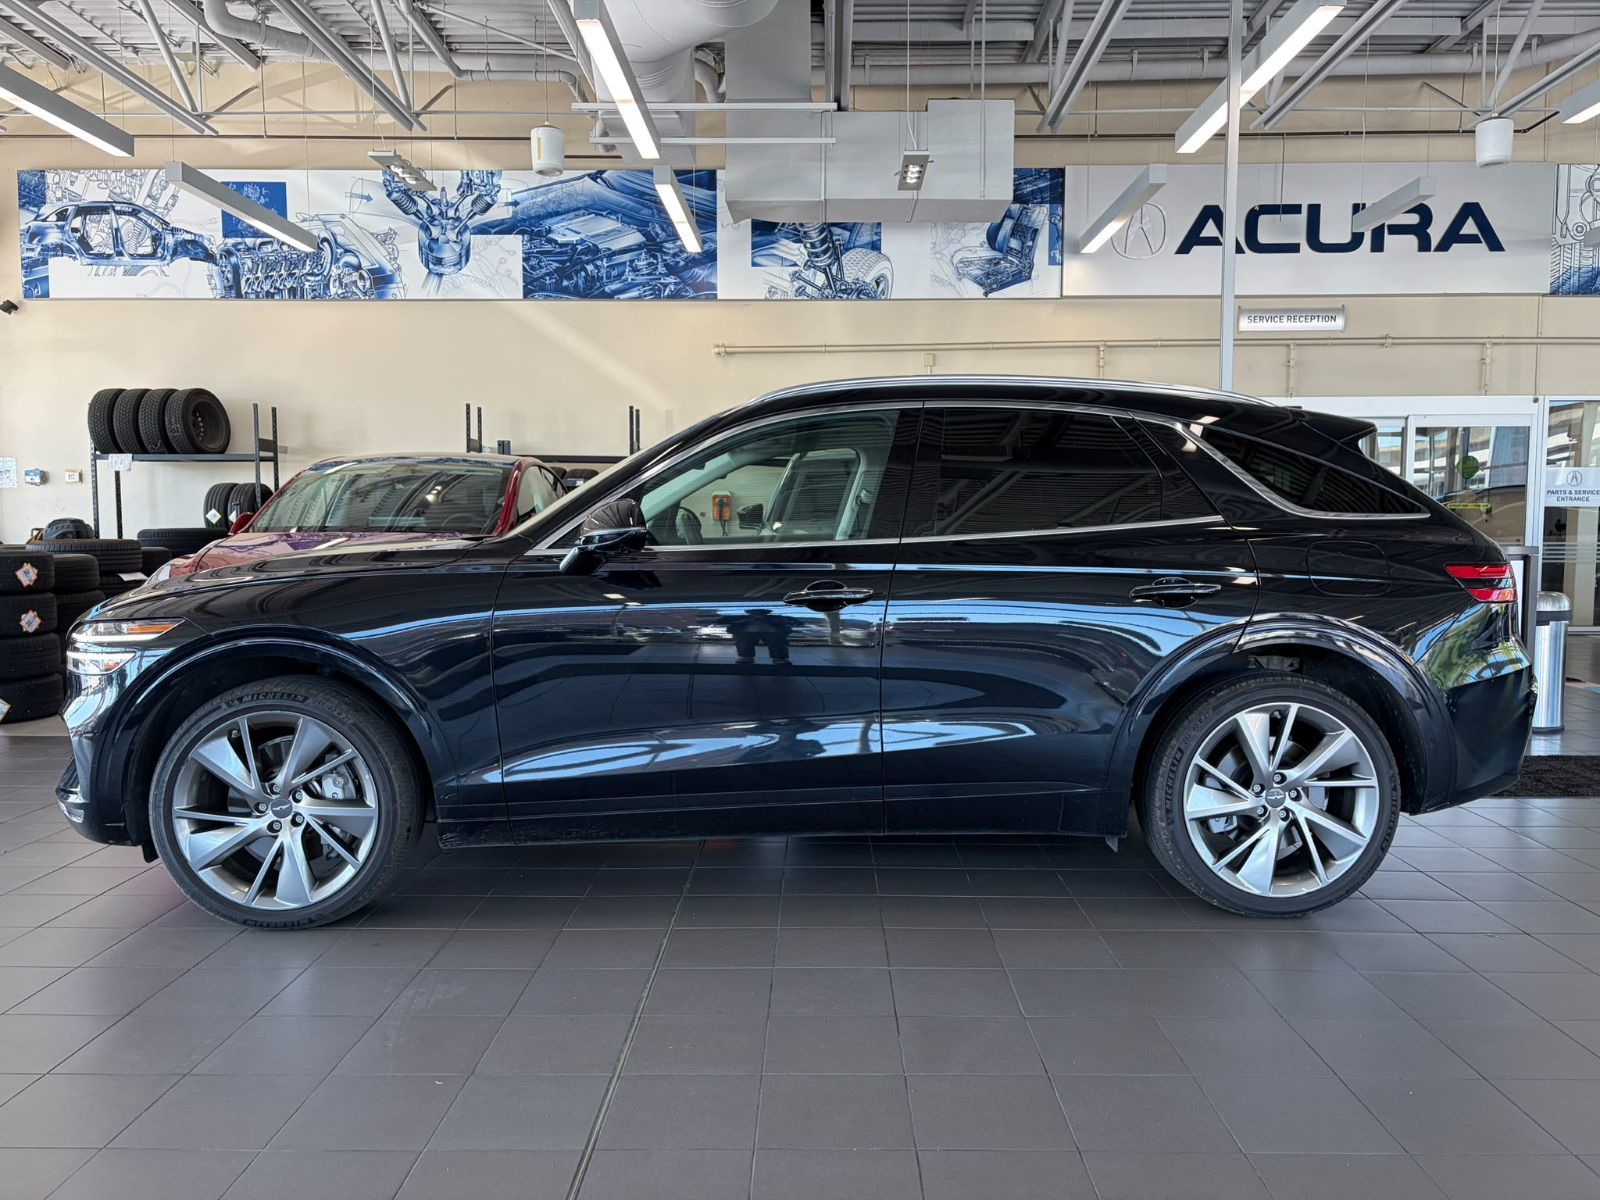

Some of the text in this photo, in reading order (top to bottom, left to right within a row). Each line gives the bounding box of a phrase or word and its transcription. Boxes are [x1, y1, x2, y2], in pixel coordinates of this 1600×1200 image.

[1174, 202, 1506, 255] ACURA
[1247, 314, 1337, 324] SERVICE RECEPTION
[241, 692, 306, 702] MICHELIN
[1165, 749, 1184, 809] MICHELIN
